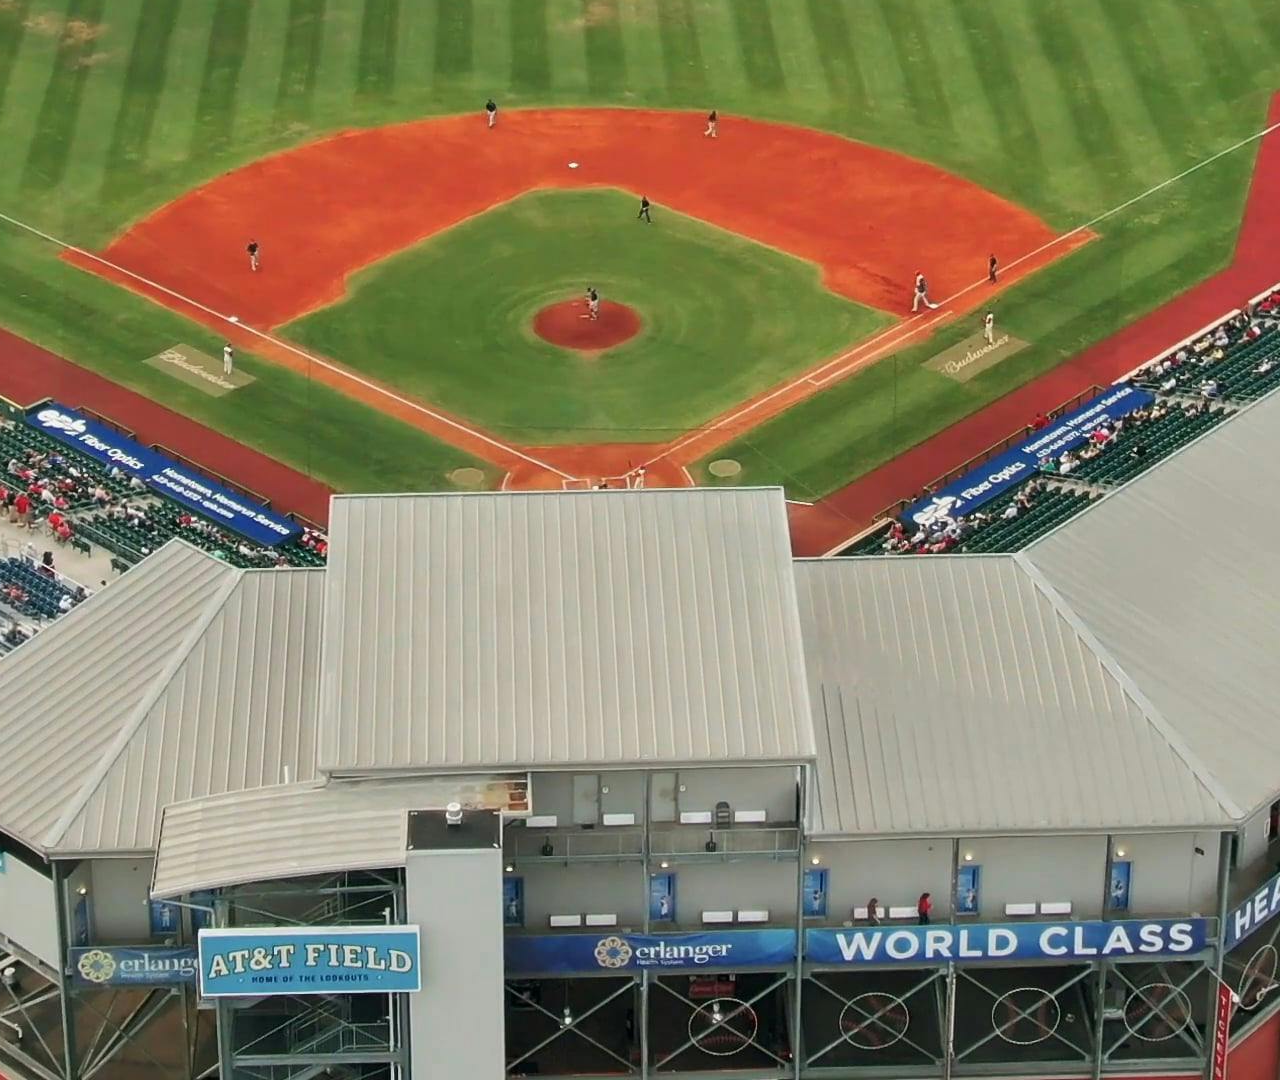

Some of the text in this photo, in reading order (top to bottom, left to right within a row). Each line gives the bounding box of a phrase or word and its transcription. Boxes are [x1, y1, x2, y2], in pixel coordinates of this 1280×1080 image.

[1021, 386, 1133, 454] Hometown, Homerun Service
[37, 409, 145, 470] epb Fiber Optics
[961, 478, 992, 502] Fiber
[988, 461, 1026, 485] Optics
[254, 514, 290, 536] Service
[208, 942, 413, 979] AT&T FIELD
[635, 942, 732, 963] erlanger
[835, 922, 1194, 962] WORLD CLASS
[252, 974, 369, 984] HOME OF THE LOOKOUTS
